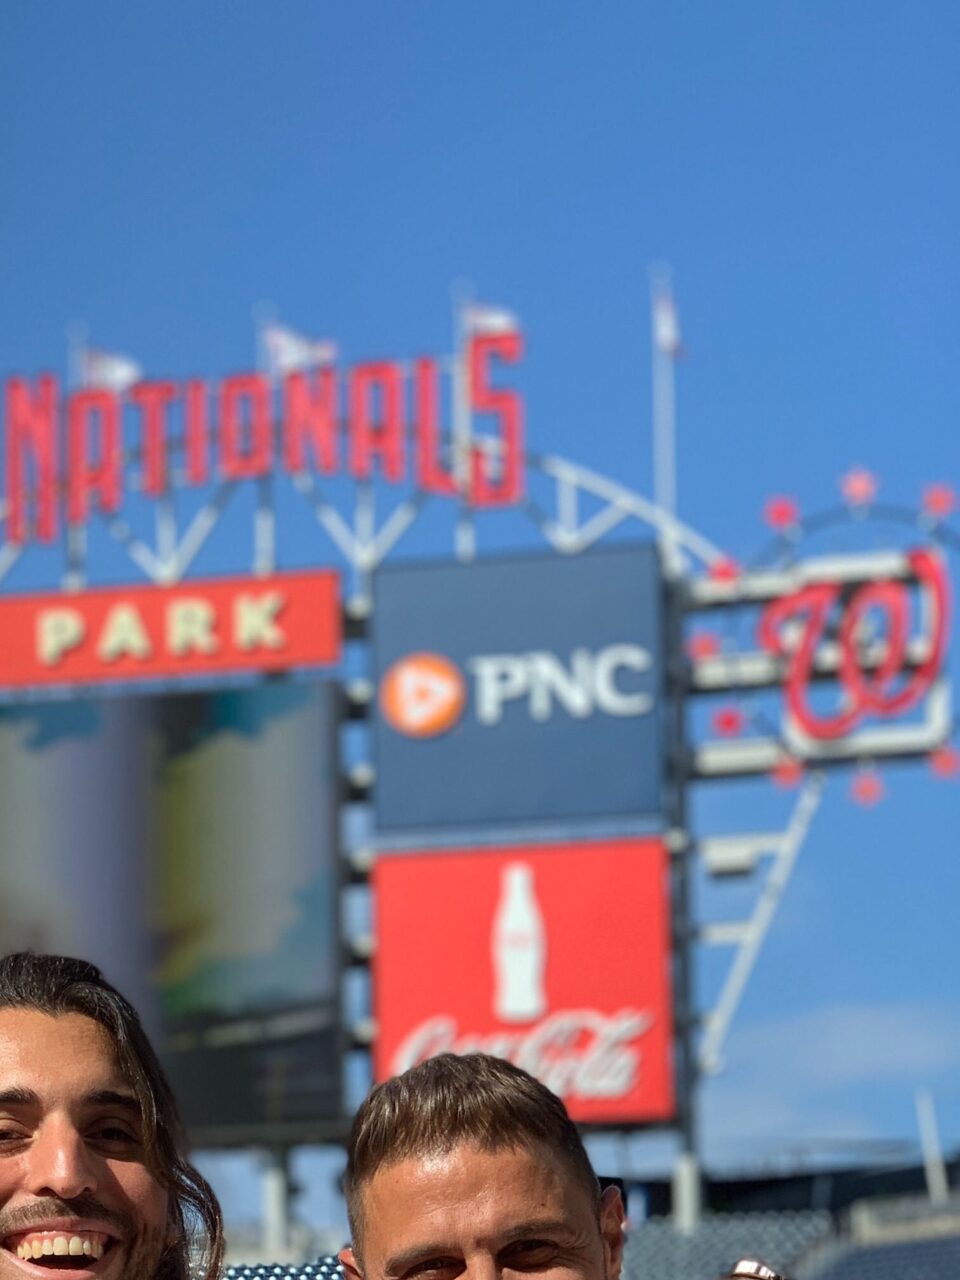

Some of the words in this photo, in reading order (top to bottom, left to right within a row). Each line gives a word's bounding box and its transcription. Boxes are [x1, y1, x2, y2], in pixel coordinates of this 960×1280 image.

[3, 331, 524, 546] NATIONALS
[36, 592, 285, 664] PARK
[469, 644, 655, 724] PNC
